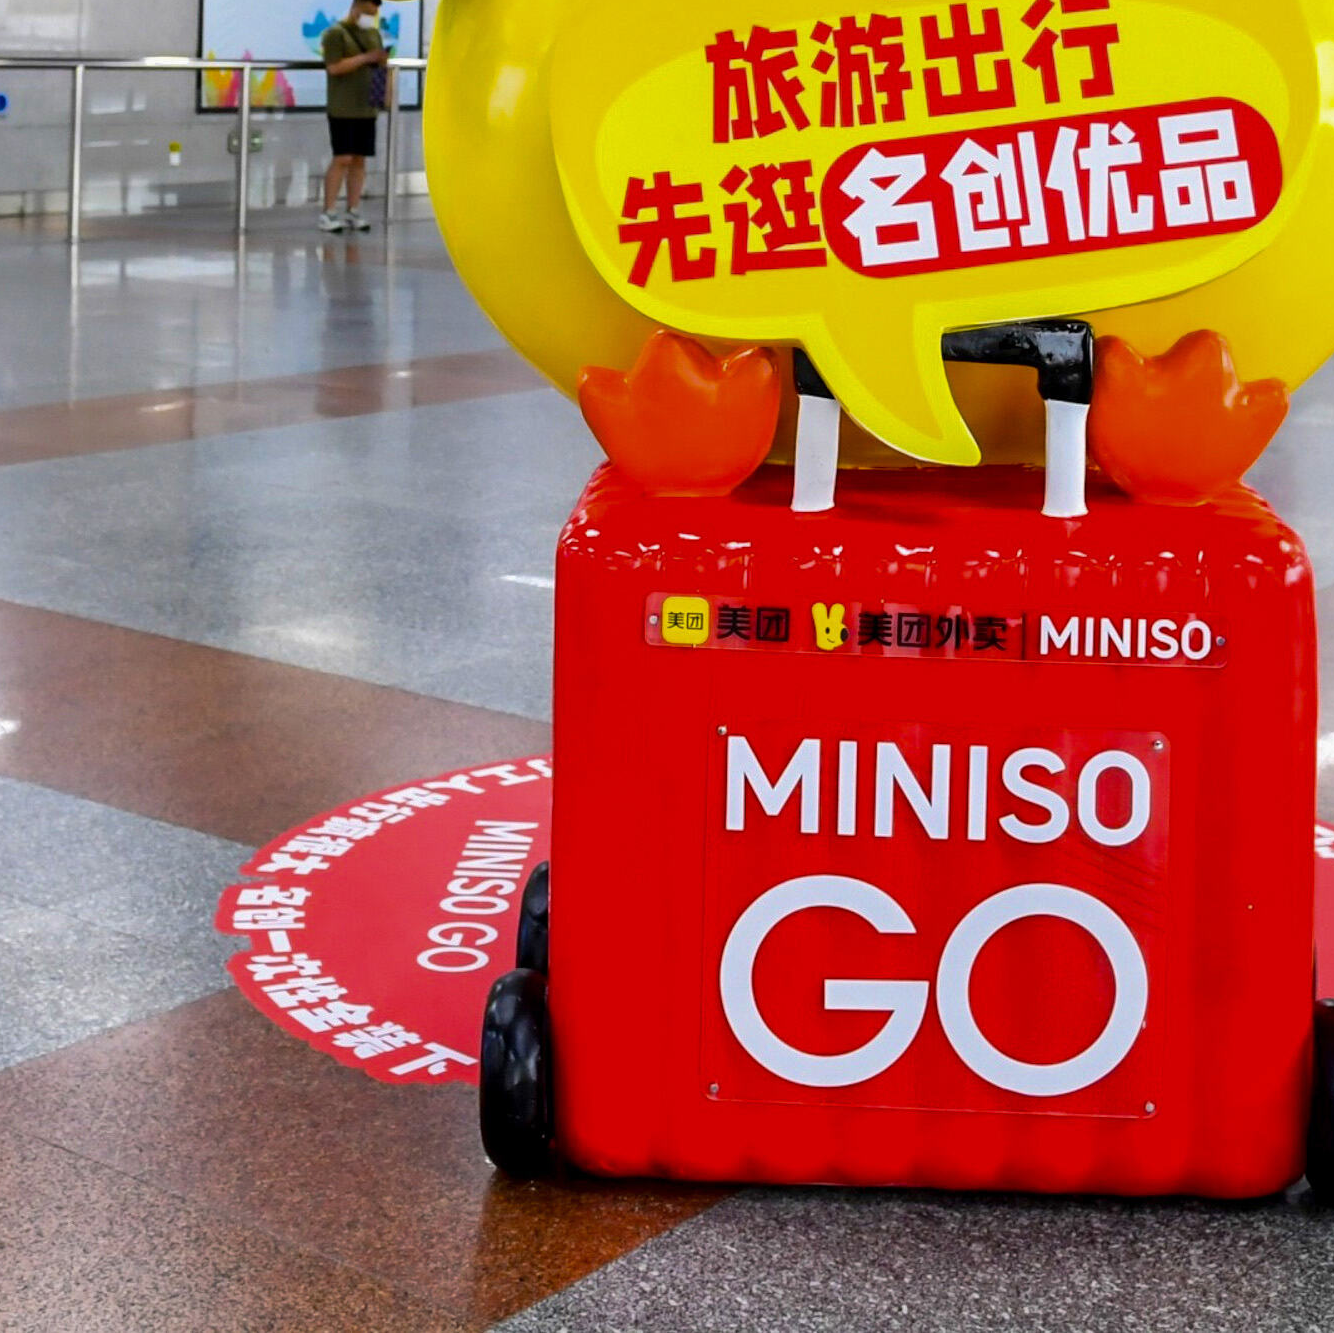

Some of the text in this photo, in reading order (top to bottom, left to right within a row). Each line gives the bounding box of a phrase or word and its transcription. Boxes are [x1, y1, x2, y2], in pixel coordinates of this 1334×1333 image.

[617, 108, 1257, 289] 先逛名创优品
[666, 604, 1213, 661] 美团 美团 美团外卖 MINISO
[725, 734, 1152, 848] MINISO
[415, 819, 540, 974] MINISO GO
[719, 873, 1150, 1098] GO
